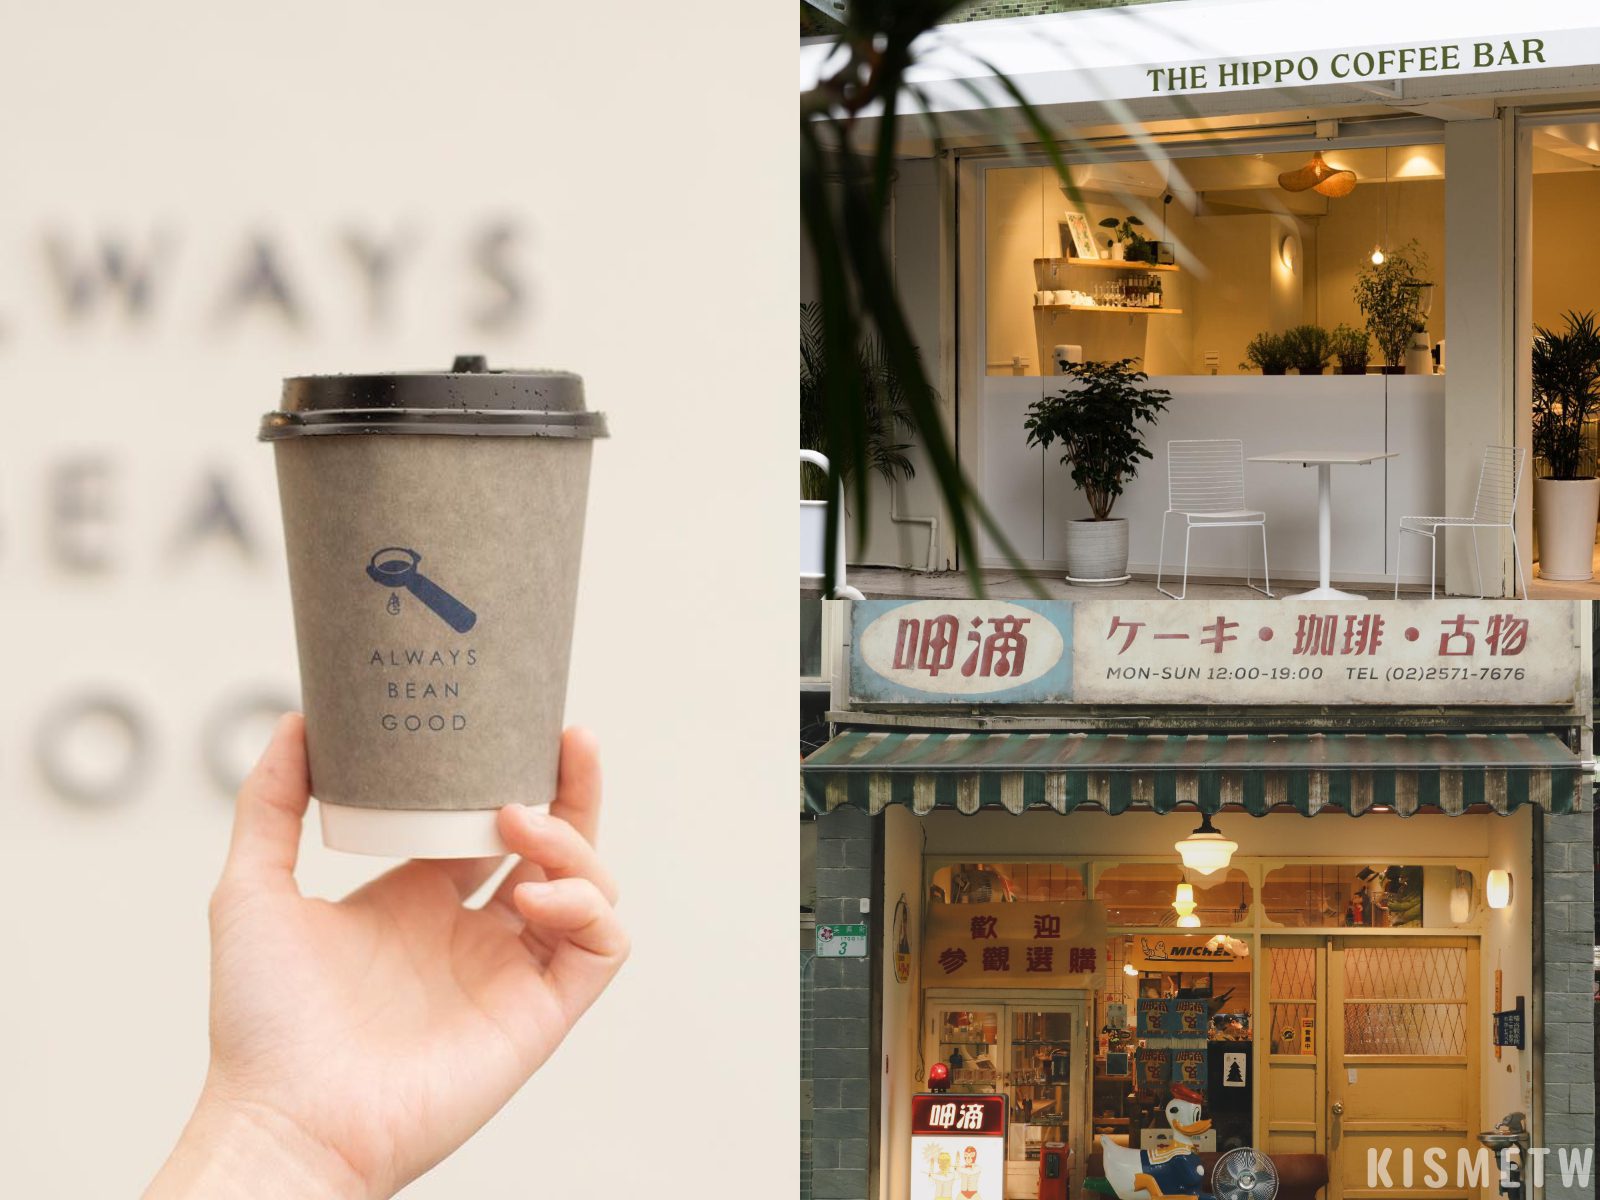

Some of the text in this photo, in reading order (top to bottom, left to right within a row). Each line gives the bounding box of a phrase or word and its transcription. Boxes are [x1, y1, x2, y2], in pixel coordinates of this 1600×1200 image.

[1147, 38, 1546, 91] THE HIPPO COFFEE BAR
[892, 614, 1031, 677] 呷滴
[370, 650, 477, 666] ALWAYS
[1106, 665, 1526, 682] MON-SUN 12:00-19:00 TEL (02)2571-7676
[388, 682, 459, 698] BEAN
[382, 714, 466, 731] GOOD
[970, 914, 1060, 940] 歡迎
[838, 941, 848, 955] 3
[929, 1103, 984, 1129] 呷滴
